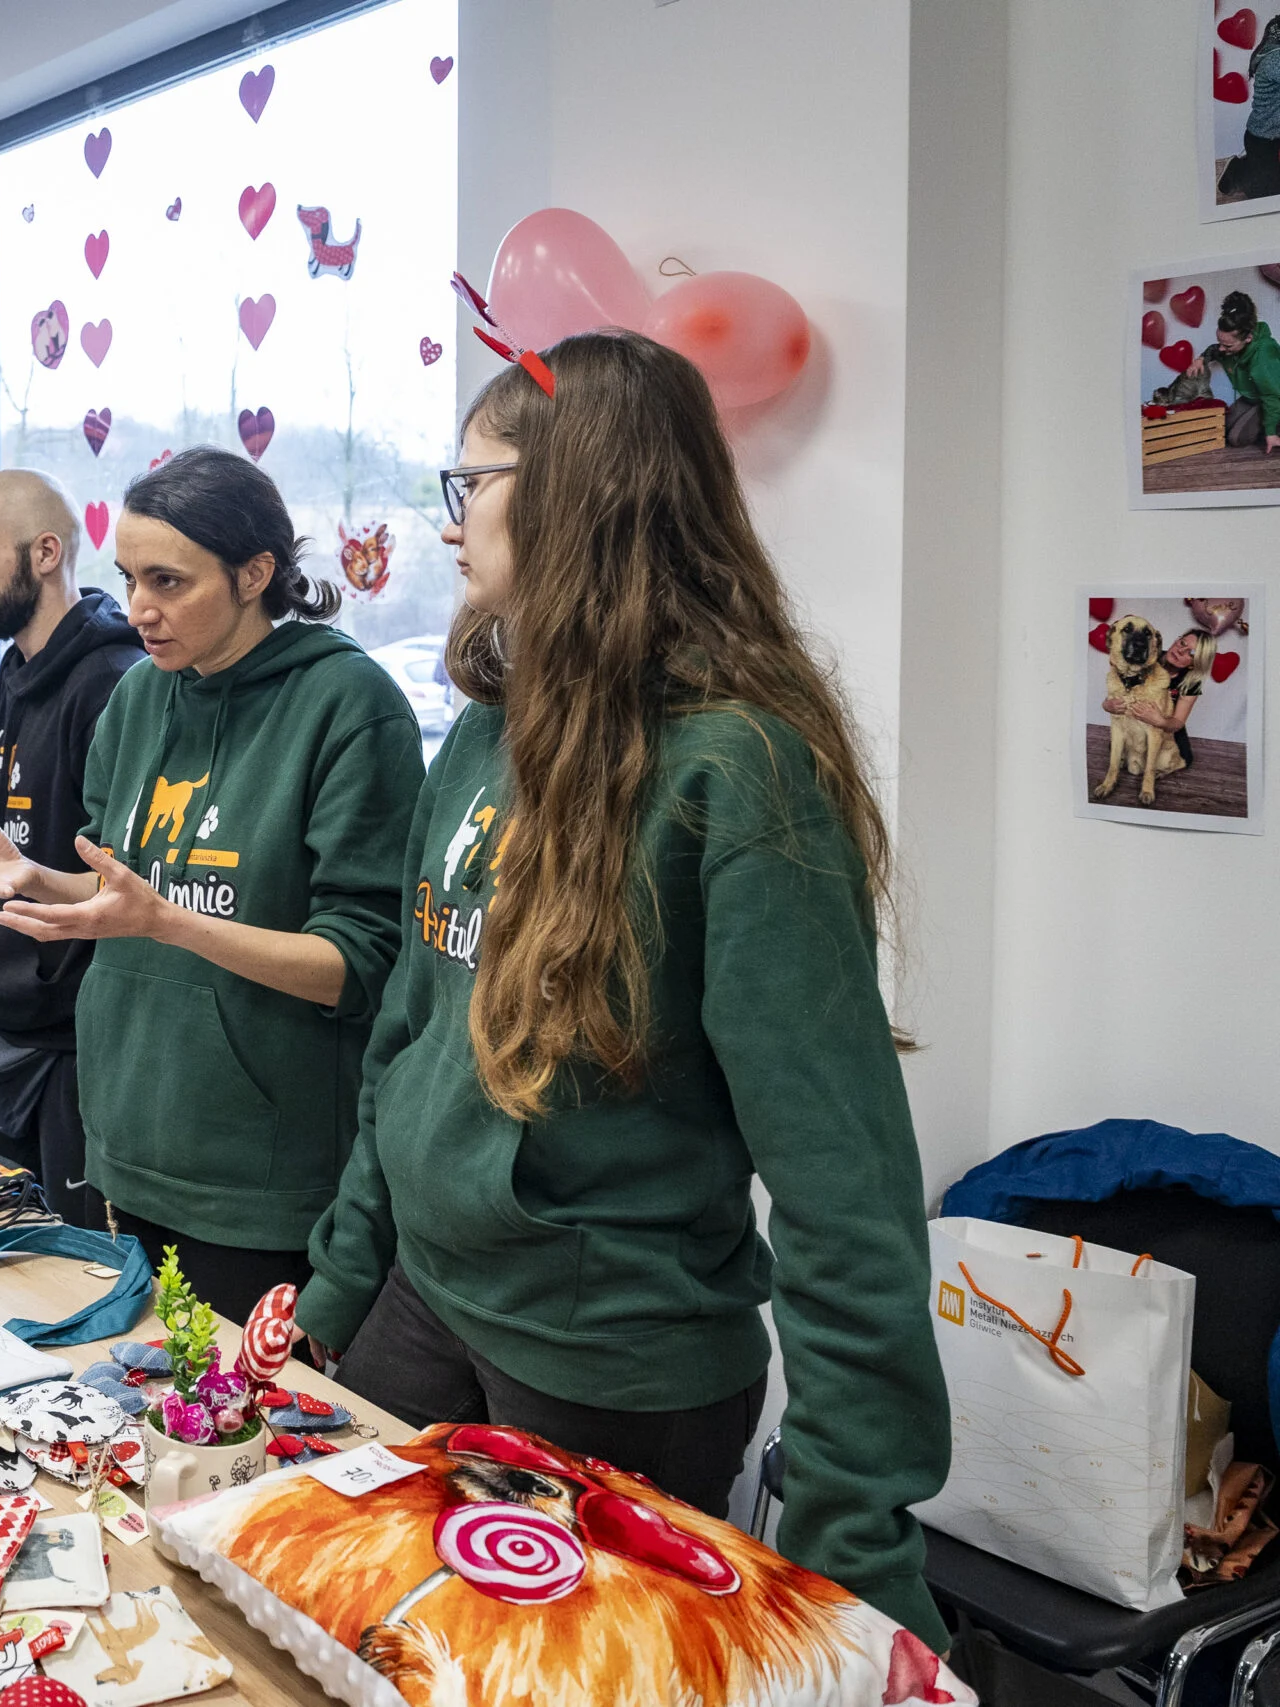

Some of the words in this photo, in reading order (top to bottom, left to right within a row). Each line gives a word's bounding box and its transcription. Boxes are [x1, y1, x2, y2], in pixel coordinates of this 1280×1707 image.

[170, 874, 235, 917] mnie
[970, 1308, 998, 1325] Metali
[970, 1319, 1003, 1338] Gliwice
